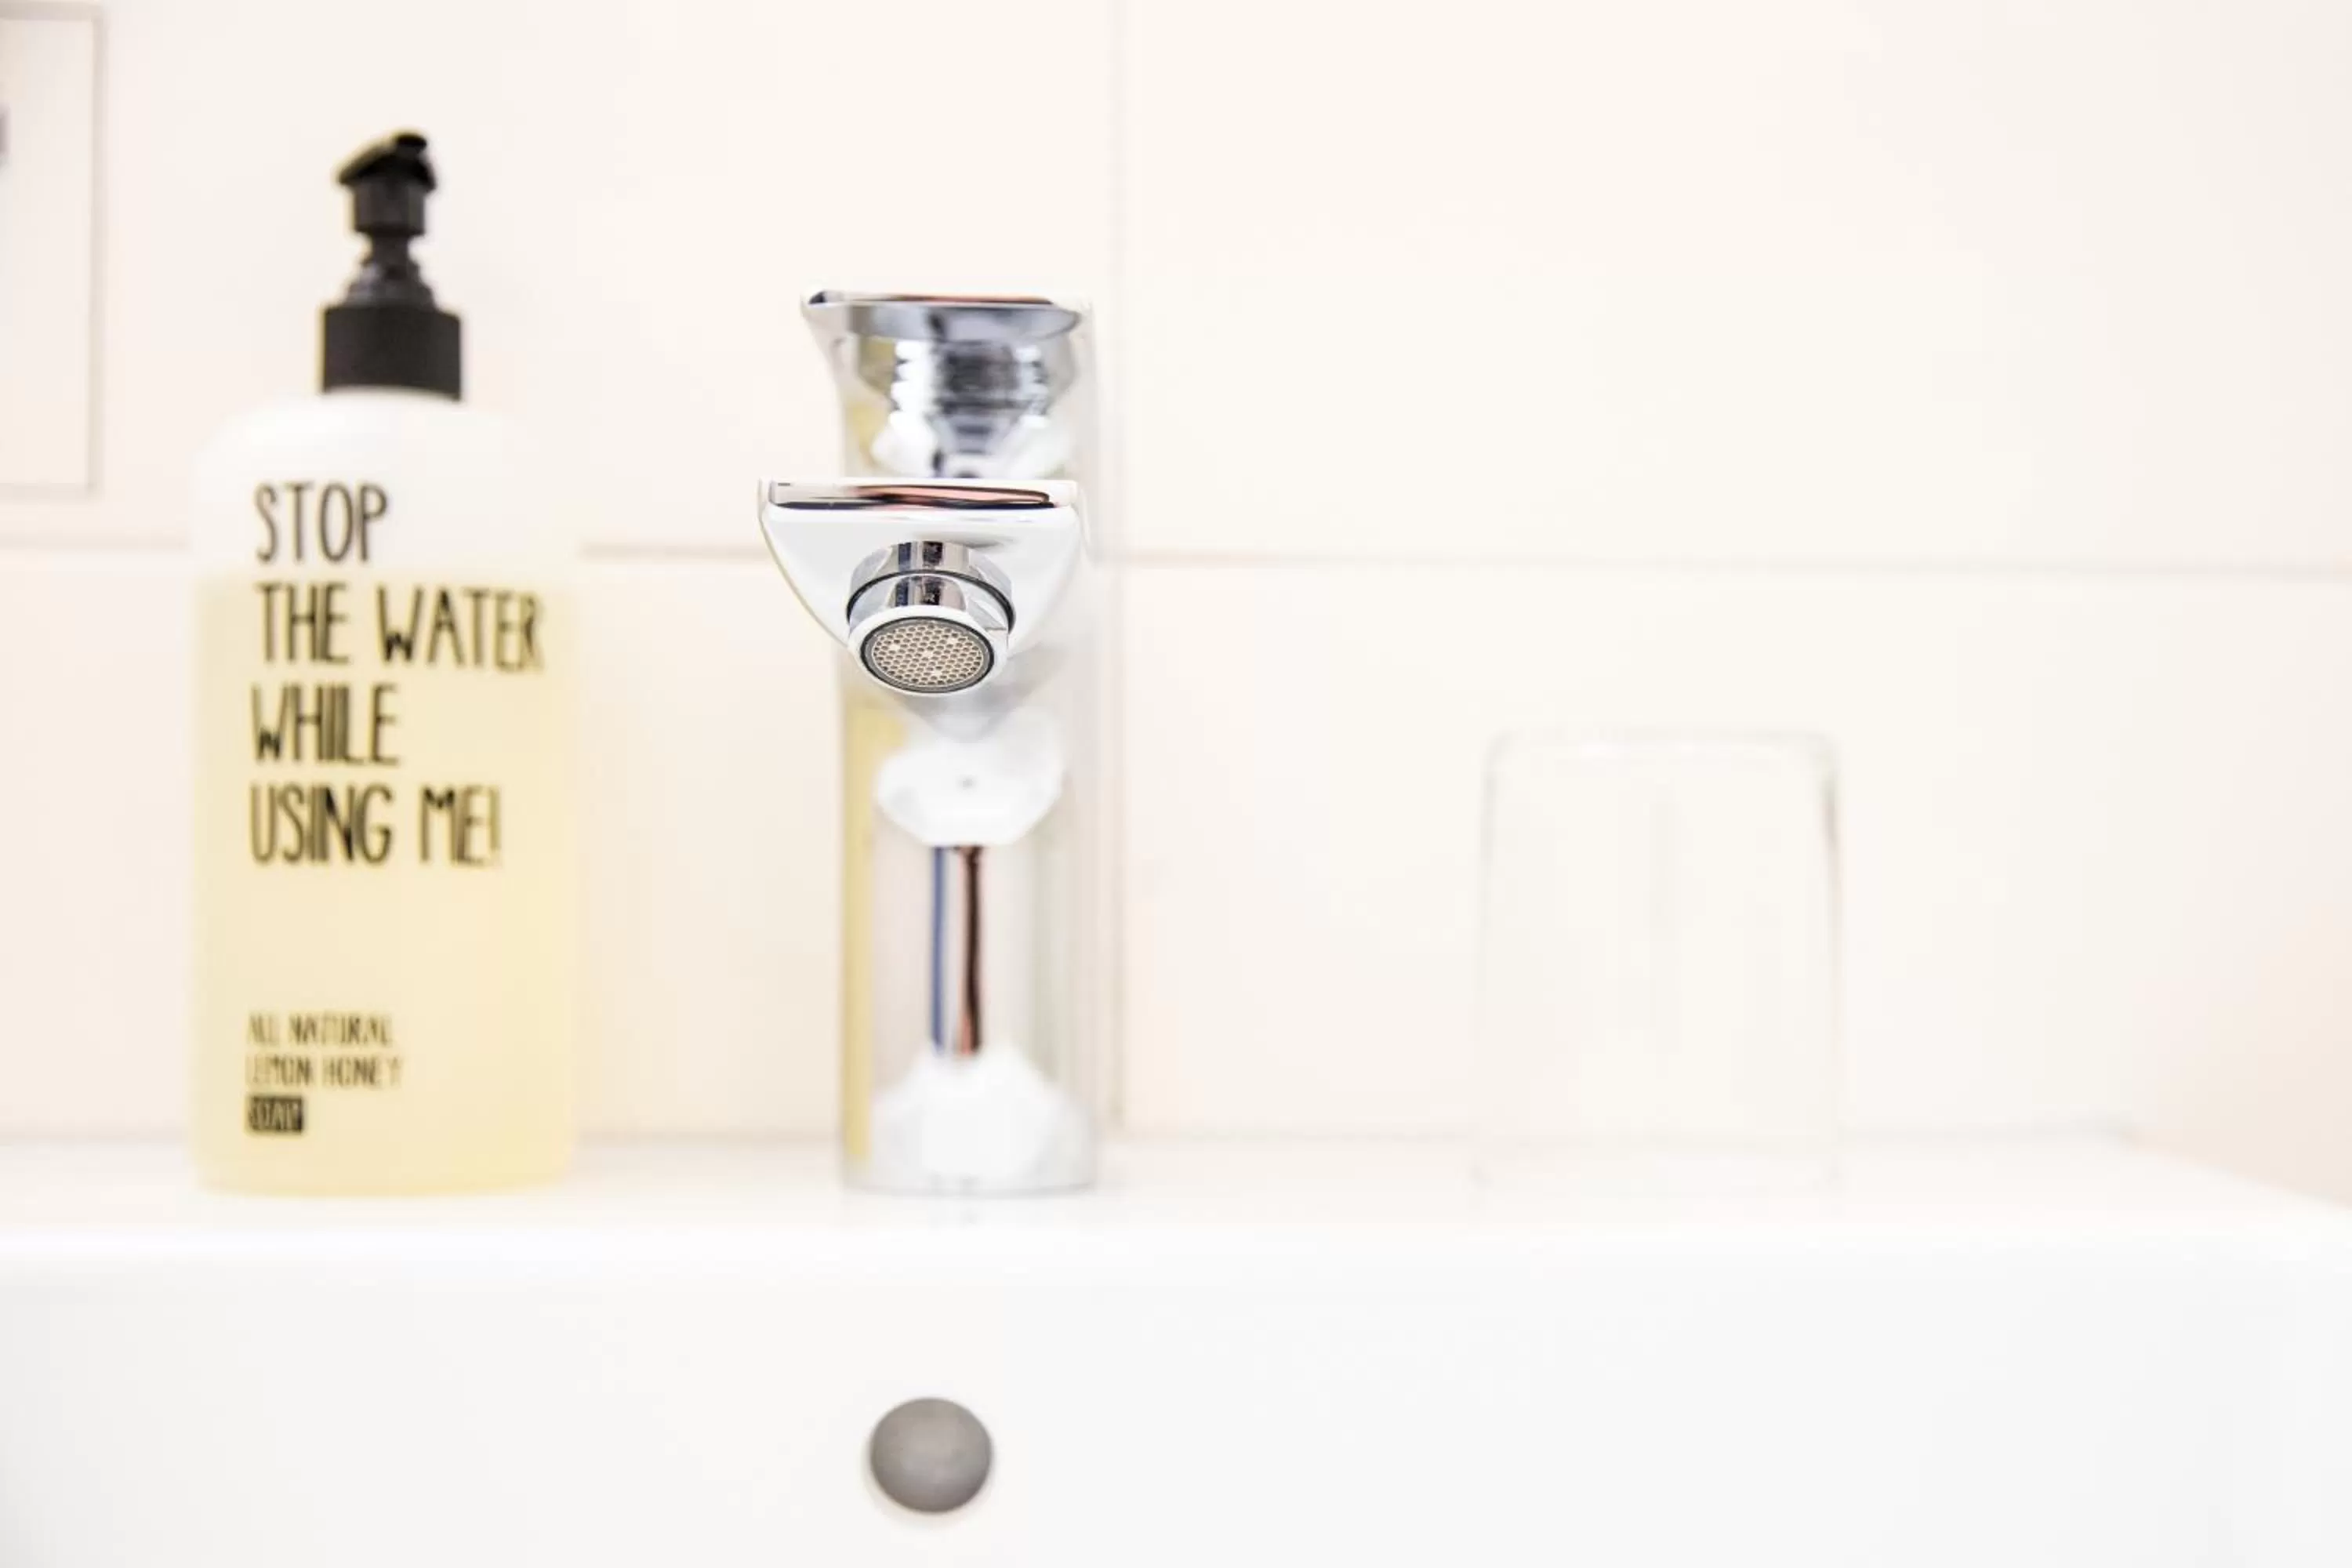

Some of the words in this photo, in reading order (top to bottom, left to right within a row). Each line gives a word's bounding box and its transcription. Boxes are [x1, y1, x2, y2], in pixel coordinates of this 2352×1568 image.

[253, 480, 389, 564] STOP
[255, 581, 350, 666] THE
[374, 583, 543, 673] WATER
[250, 682, 401, 766] WHILE
[250, 783, 394, 866] USING
[419, 783, 502, 868] ME!
